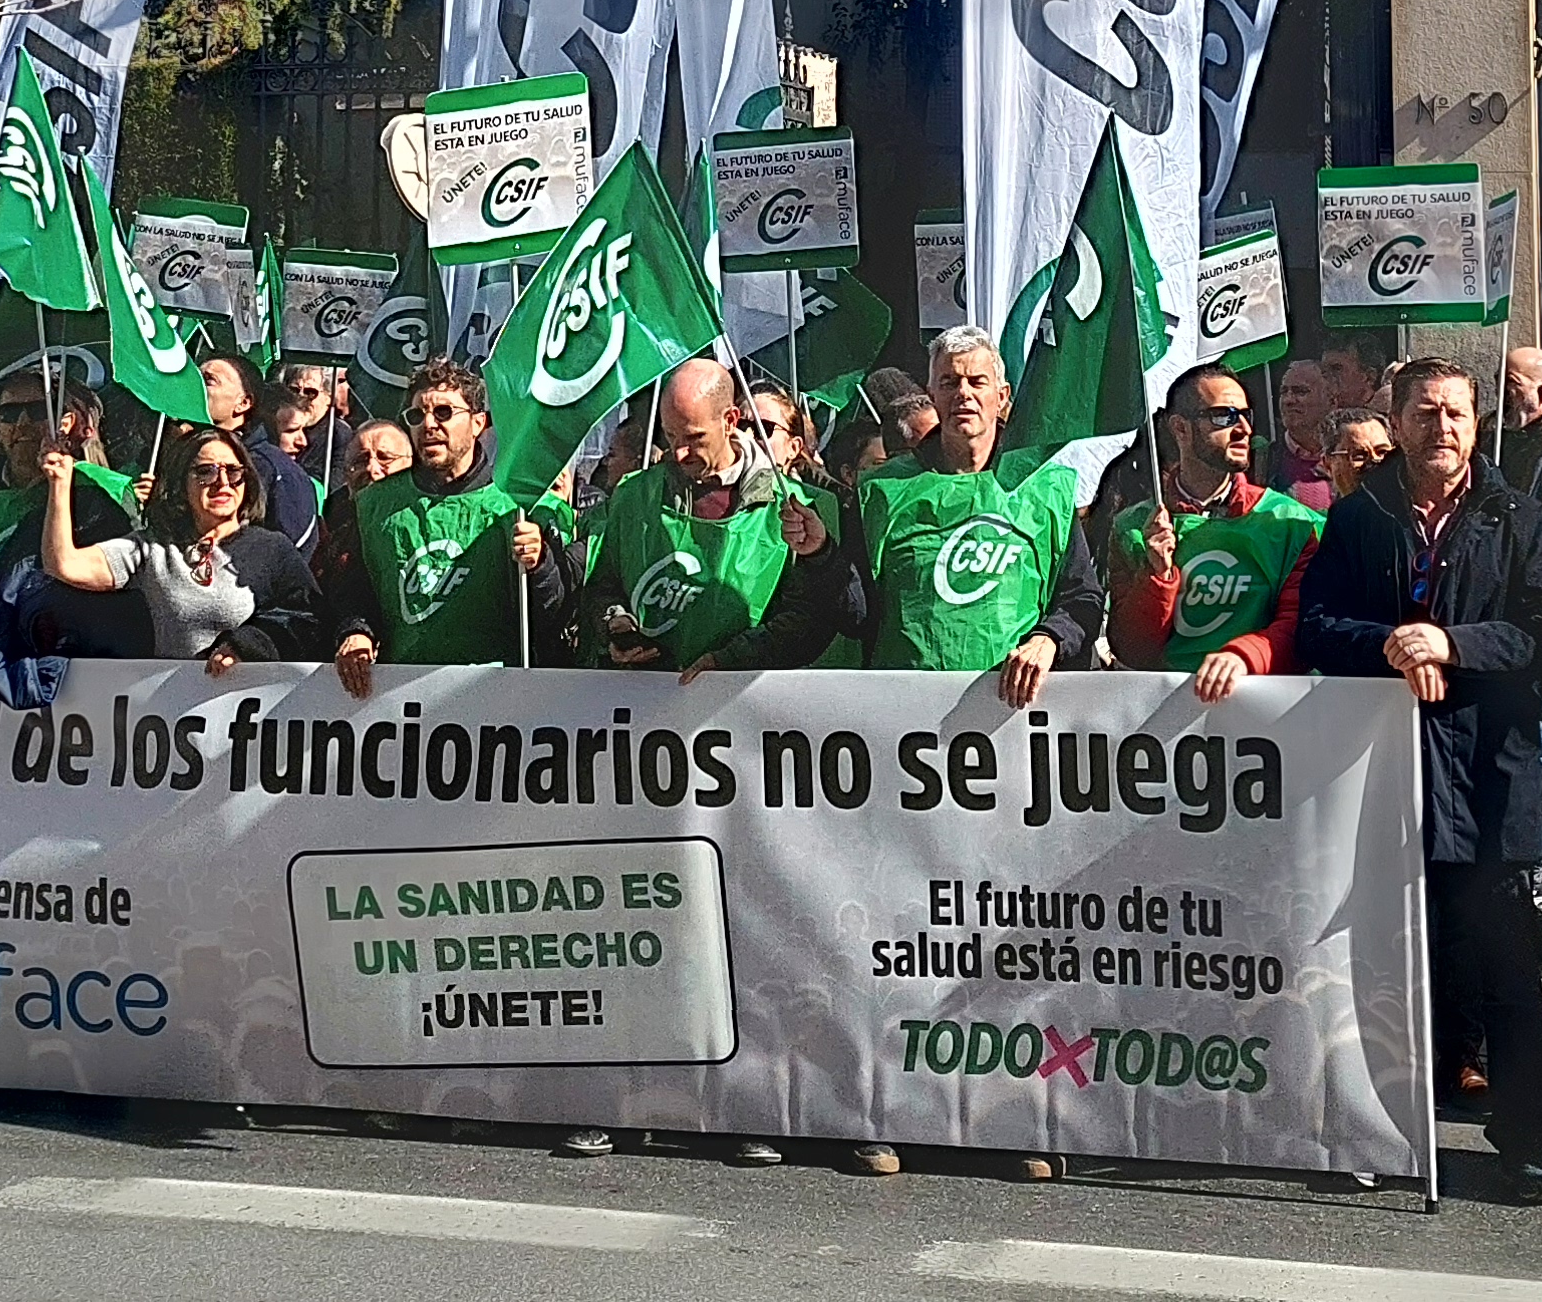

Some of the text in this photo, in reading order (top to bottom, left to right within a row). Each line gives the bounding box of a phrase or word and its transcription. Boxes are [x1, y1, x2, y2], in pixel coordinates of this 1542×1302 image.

[434, 104, 583, 134] EL FUTURO DE TU SALUD
[1468, 91, 1508, 125] 50
[435, 128, 529, 150] ESTA EN JUEGO
[717, 148, 842, 167] EL FUTURO DE TU SALUD
[718, 165, 795, 180] ESTA EN JUEGO
[442, 162, 488, 203] ÚNETE!
[495, 177, 548, 205] CSIF
[725, 190, 761, 223] ÚNETE!
[769, 204, 814, 225] CSIF
[836, 181, 850, 240] muface
[1323, 192, 1471, 207] EL FUTURO DE TU SALUD
[1324, 209, 1415, 221] ESTA EN JUEGO
[135, 225, 153, 235] CON
[153, 227, 164, 235] LA
[192, 232, 205, 240] NO
[916, 237, 934, 247] CON
[936, 237, 948, 246] LA
[1224, 262, 1238, 271] NO
[1240, 259, 1250, 267] SE
[1251, 249, 1278, 264] JUEGA
[1331, 234, 1375, 269] ÚNETE!
[1382, 254, 1434, 275] CSIF
[1461, 229, 1478, 295] muface
[168, 262, 205, 280] CSIF
[285, 272, 303, 282] CON
[304, 273, 316, 283] LA
[317, 274, 344, 285] SALUD
[345, 277, 359, 286] NO
[547, 231, 633, 359] CSIF
[1210, 295, 1247, 322] CSIF
[325, 309, 361, 325] CSIF
[954, 540, 1022, 575] CSIF
[643, 576, 705, 612] CSIF
[1186, 574, 1252, 606] CSIF
[11, 701, 94, 786] de
[110, 695, 207, 791] los
[228, 697, 737, 808] funcionarios
[762, 729, 872, 808] no
[897, 730, 998, 810] se
[1023, 710, 1283, 833] juega
[85, 876, 132, 926] de
[325, 872, 683, 921] LA SANIDAD ES
[928, 879, 1223, 937] El futuro de tu
[353, 930, 663, 975] UN DERECHO
[871, 932, 1284, 1000] salud está en riesgo
[421, 984, 605, 1037] ¡ÚNETE!
